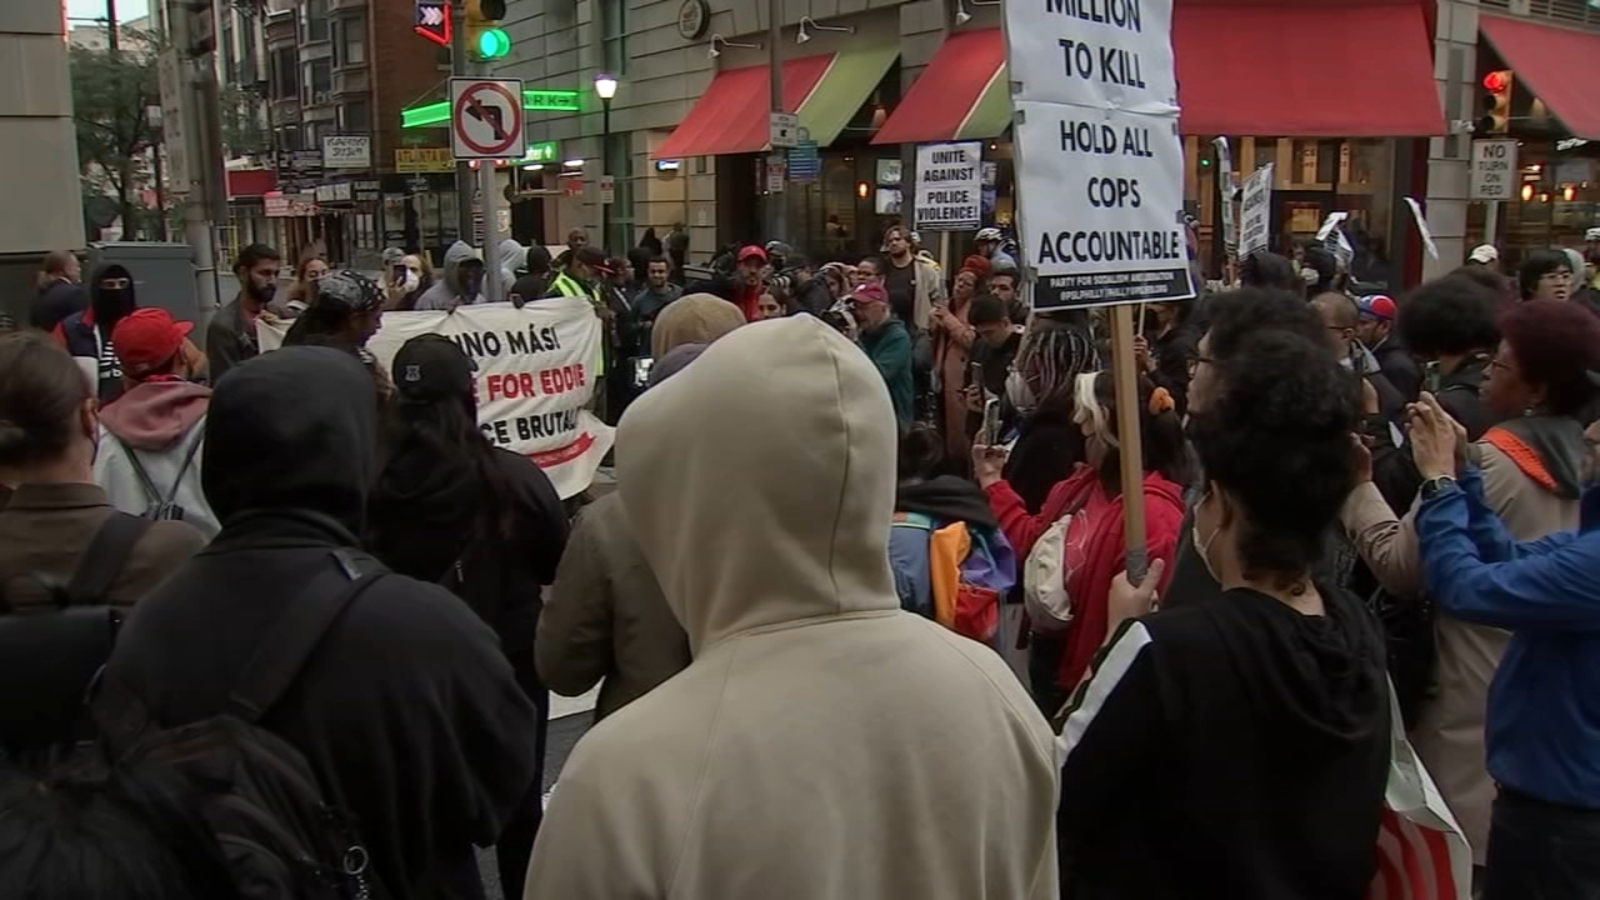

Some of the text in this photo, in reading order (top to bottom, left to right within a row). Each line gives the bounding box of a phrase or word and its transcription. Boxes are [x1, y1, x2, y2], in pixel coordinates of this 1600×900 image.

[1058, 38, 1146, 89] TO KILL
[1060, 120, 1153, 157] HOLD ALL
[932, 150, 966, 164] UNITE
[1483, 144, 1506, 158] NO
[1479, 161, 1508, 171] TURN
[924, 167, 974, 182] AGAINST
[1484, 172, 1501, 182] ON
[928, 190, 969, 204] POLICE
[1088, 176, 1141, 208] COPS
[1480, 184, 1504, 196] RED
[917, 206, 978, 220] VIOLENCE!
[1038, 230, 1180, 264] ACCOUNTABLE
[1049, 276, 1076, 289] PARTY
[487, 372, 536, 401] FOR
[540, 363, 585, 394] EDDIE
